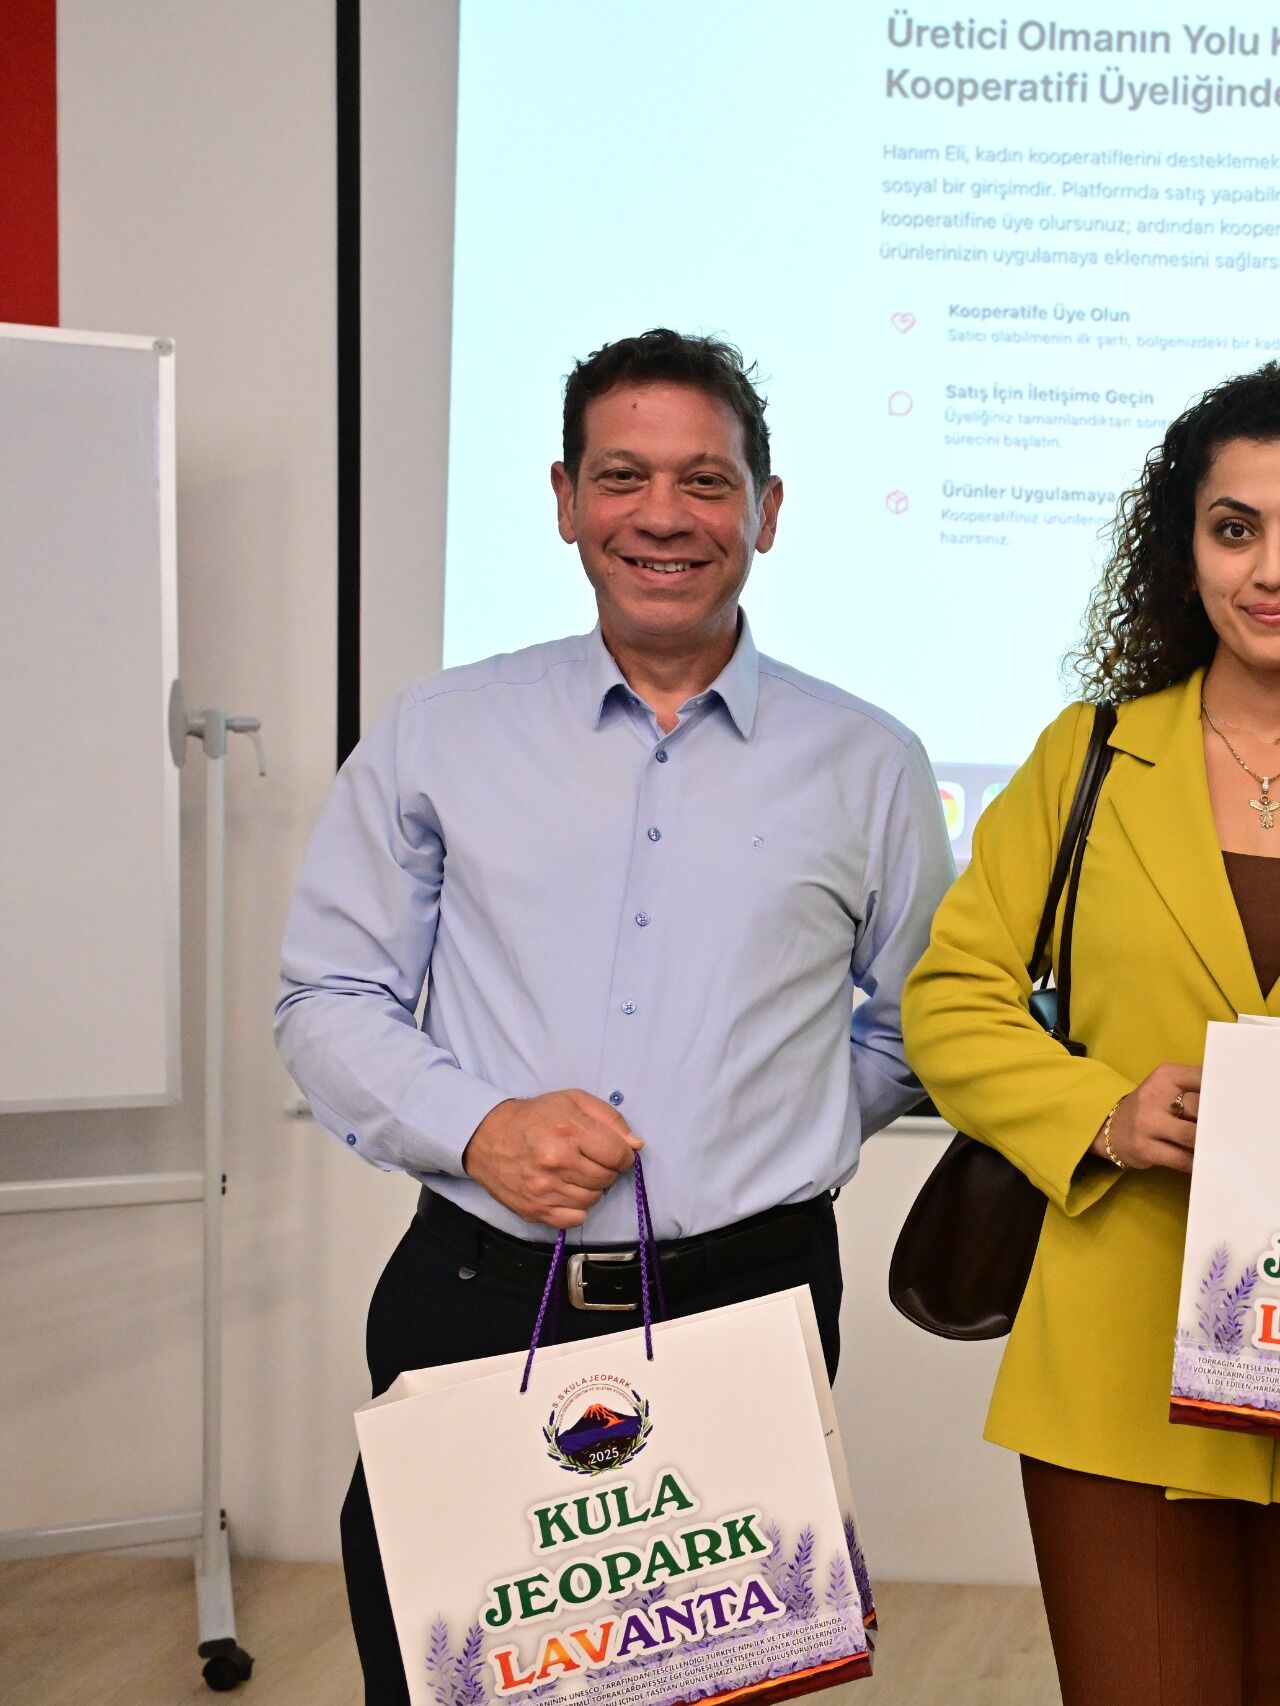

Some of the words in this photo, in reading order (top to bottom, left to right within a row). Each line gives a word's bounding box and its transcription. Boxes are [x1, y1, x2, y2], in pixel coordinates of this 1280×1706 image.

[887, 9, 1008, 50] Üretici
[1018, 21, 1171, 54] Olmanın
[1182, 24, 1259, 56] Yolu
[885, 68, 1089, 106] Kooperatifi
[883, 145, 940, 161] Hanım
[945, 145, 969, 164] Eli,
[975, 146, 1022, 163] kadın
[1029, 147, 1161, 167] kooperatiflerini
[1166, 150, 1280, 169] desteklemek
[882, 178, 937, 197] sosyal
[943, 179, 966, 194] bir
[970, 179, 1056, 200] girişimdir.
[1062, 181, 1159, 200] Platformda
[1165, 184, 1205, 206] satış
[880, 210, 996, 231] kooperatifine
[1002, 213, 1033, 233] üye
[1039, 214, 1131, 235] olursunuz;
[1137, 218, 1214, 235] ardından
[880, 243, 987, 262] ürünlerinizin
[993, 246, 1098, 267] uygulamaya
[1104, 248, 1209, 268] eklenmesini
[949, 304, 1048, 322] Kooperatife
[1053, 303, 1086, 324] Üye
[1090, 307, 1131, 322] Olun
[948, 328, 987, 343] Satıcı
[991, 330, 1072, 345] olabilmenin
[1077, 331, 1091, 344] ilk
[1137, 334, 1227, 351] bölgenizdeki
[1232, 338, 1250, 349] bir
[946, 384, 988, 404] Satış
[993, 382, 1023, 404] İçin
[1028, 383, 1100, 405] İletişime
[1105, 389, 1154, 407] Geçin
[944, 407, 1012, 427] Üyeliğiniz
[1018, 412, 1131, 428] tamamlandıktan
[944, 432, 999, 447] sürecini
[942, 480, 1005, 499] Ürünler
[1011, 485, 1116, 504] Uygulamaya
[941, 508, 1038, 525] Kooperatifiniz
[1192, 1365, 1244, 1379] VOLKANLARIN
[1206, 1377, 1225, 1387] ELDE
[563, 1377, 588, 1395] KULA
[588, 1374, 632, 1389] JEOPARK
[588, 1447, 620, 1464] 2025
[533, 1474, 693, 1549] KULA
[485, 1514, 767, 1627] JEOPARK
[494, 1580, 779, 1690] LAVANTA
[568, 1685, 600, 1700] UNESCO
[600, 1670, 650, 1691] TARAFINDAN
[766, 1634, 776, 1643] VE
[776, 1630, 791, 1640] TEK
[790, 1615, 842, 1636] JEOPARKINDA
[591, 1681, 647, 1704] TOPRAKLARDA
[668, 1671, 683, 1681] EGE
[754, 1640, 790, 1656] LAVANTA
